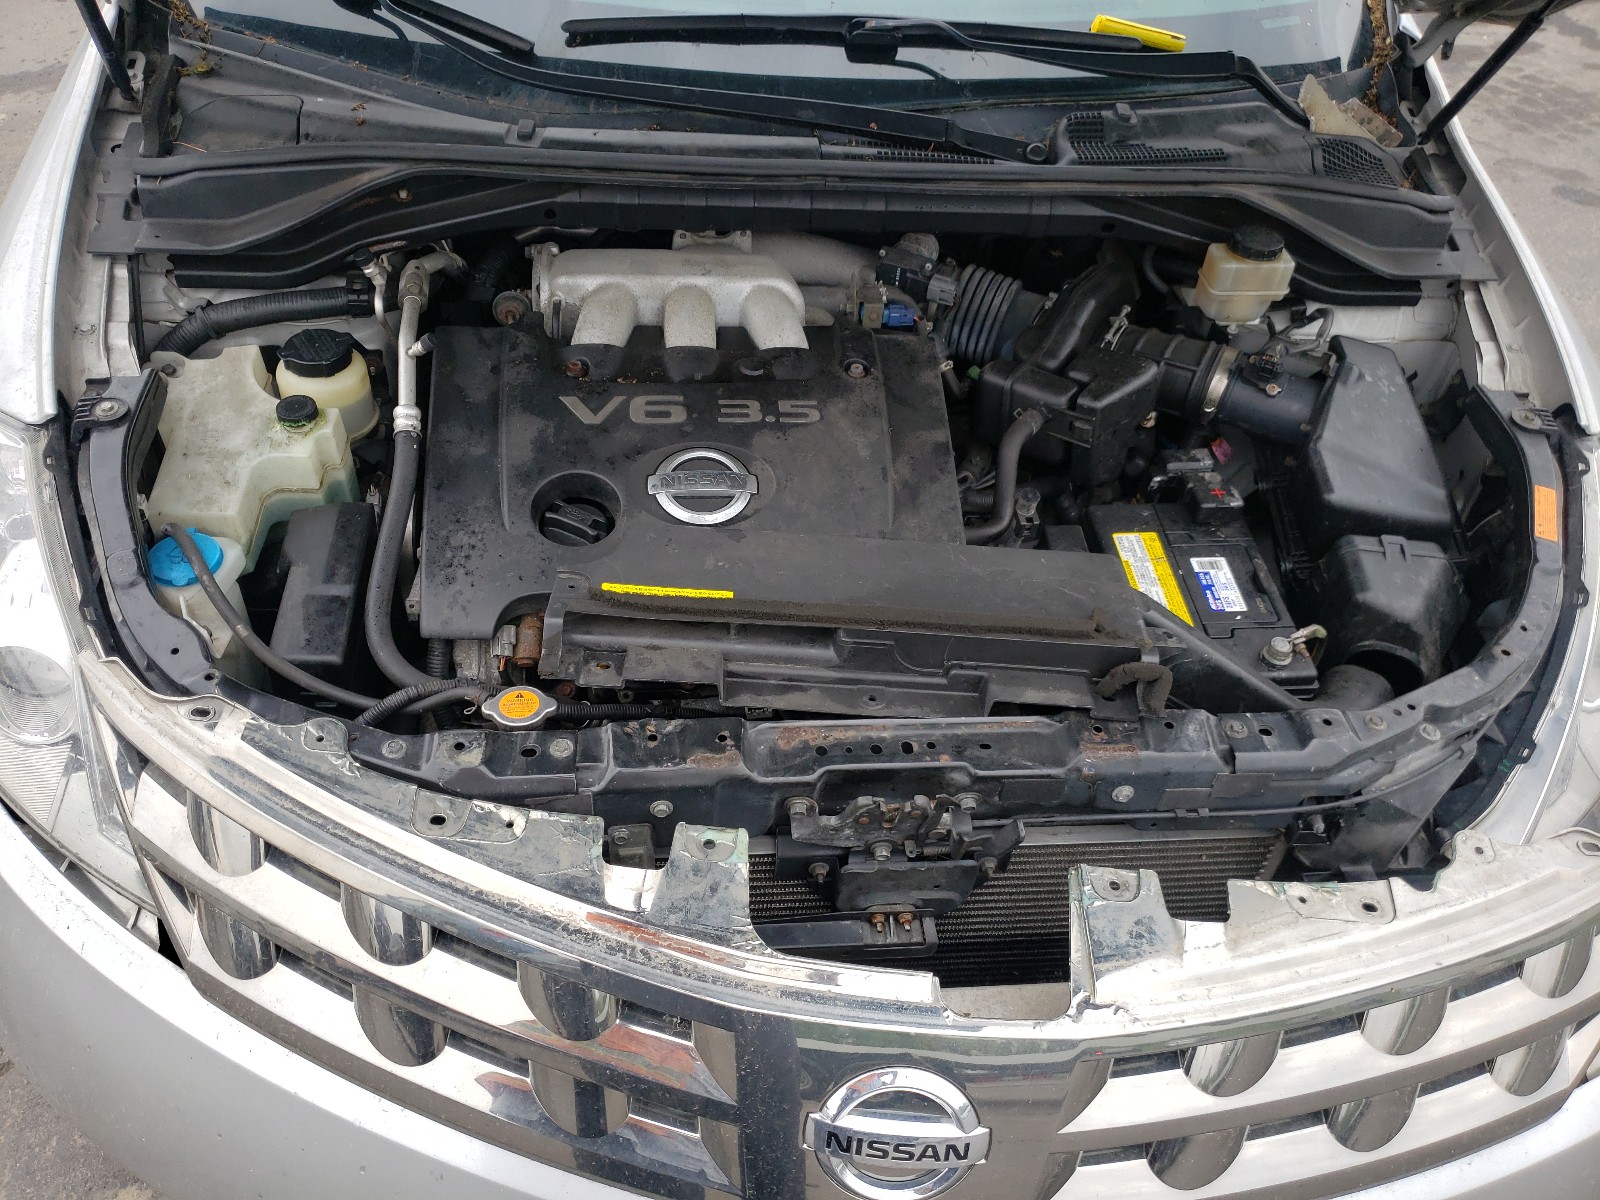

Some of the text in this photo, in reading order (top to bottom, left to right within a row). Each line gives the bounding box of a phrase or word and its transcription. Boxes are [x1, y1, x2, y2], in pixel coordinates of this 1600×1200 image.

[558, 395, 822, 425] V6 3.5
[660, 474, 747, 490] NISSAN
[825, 1130, 971, 1163] NISSAN
